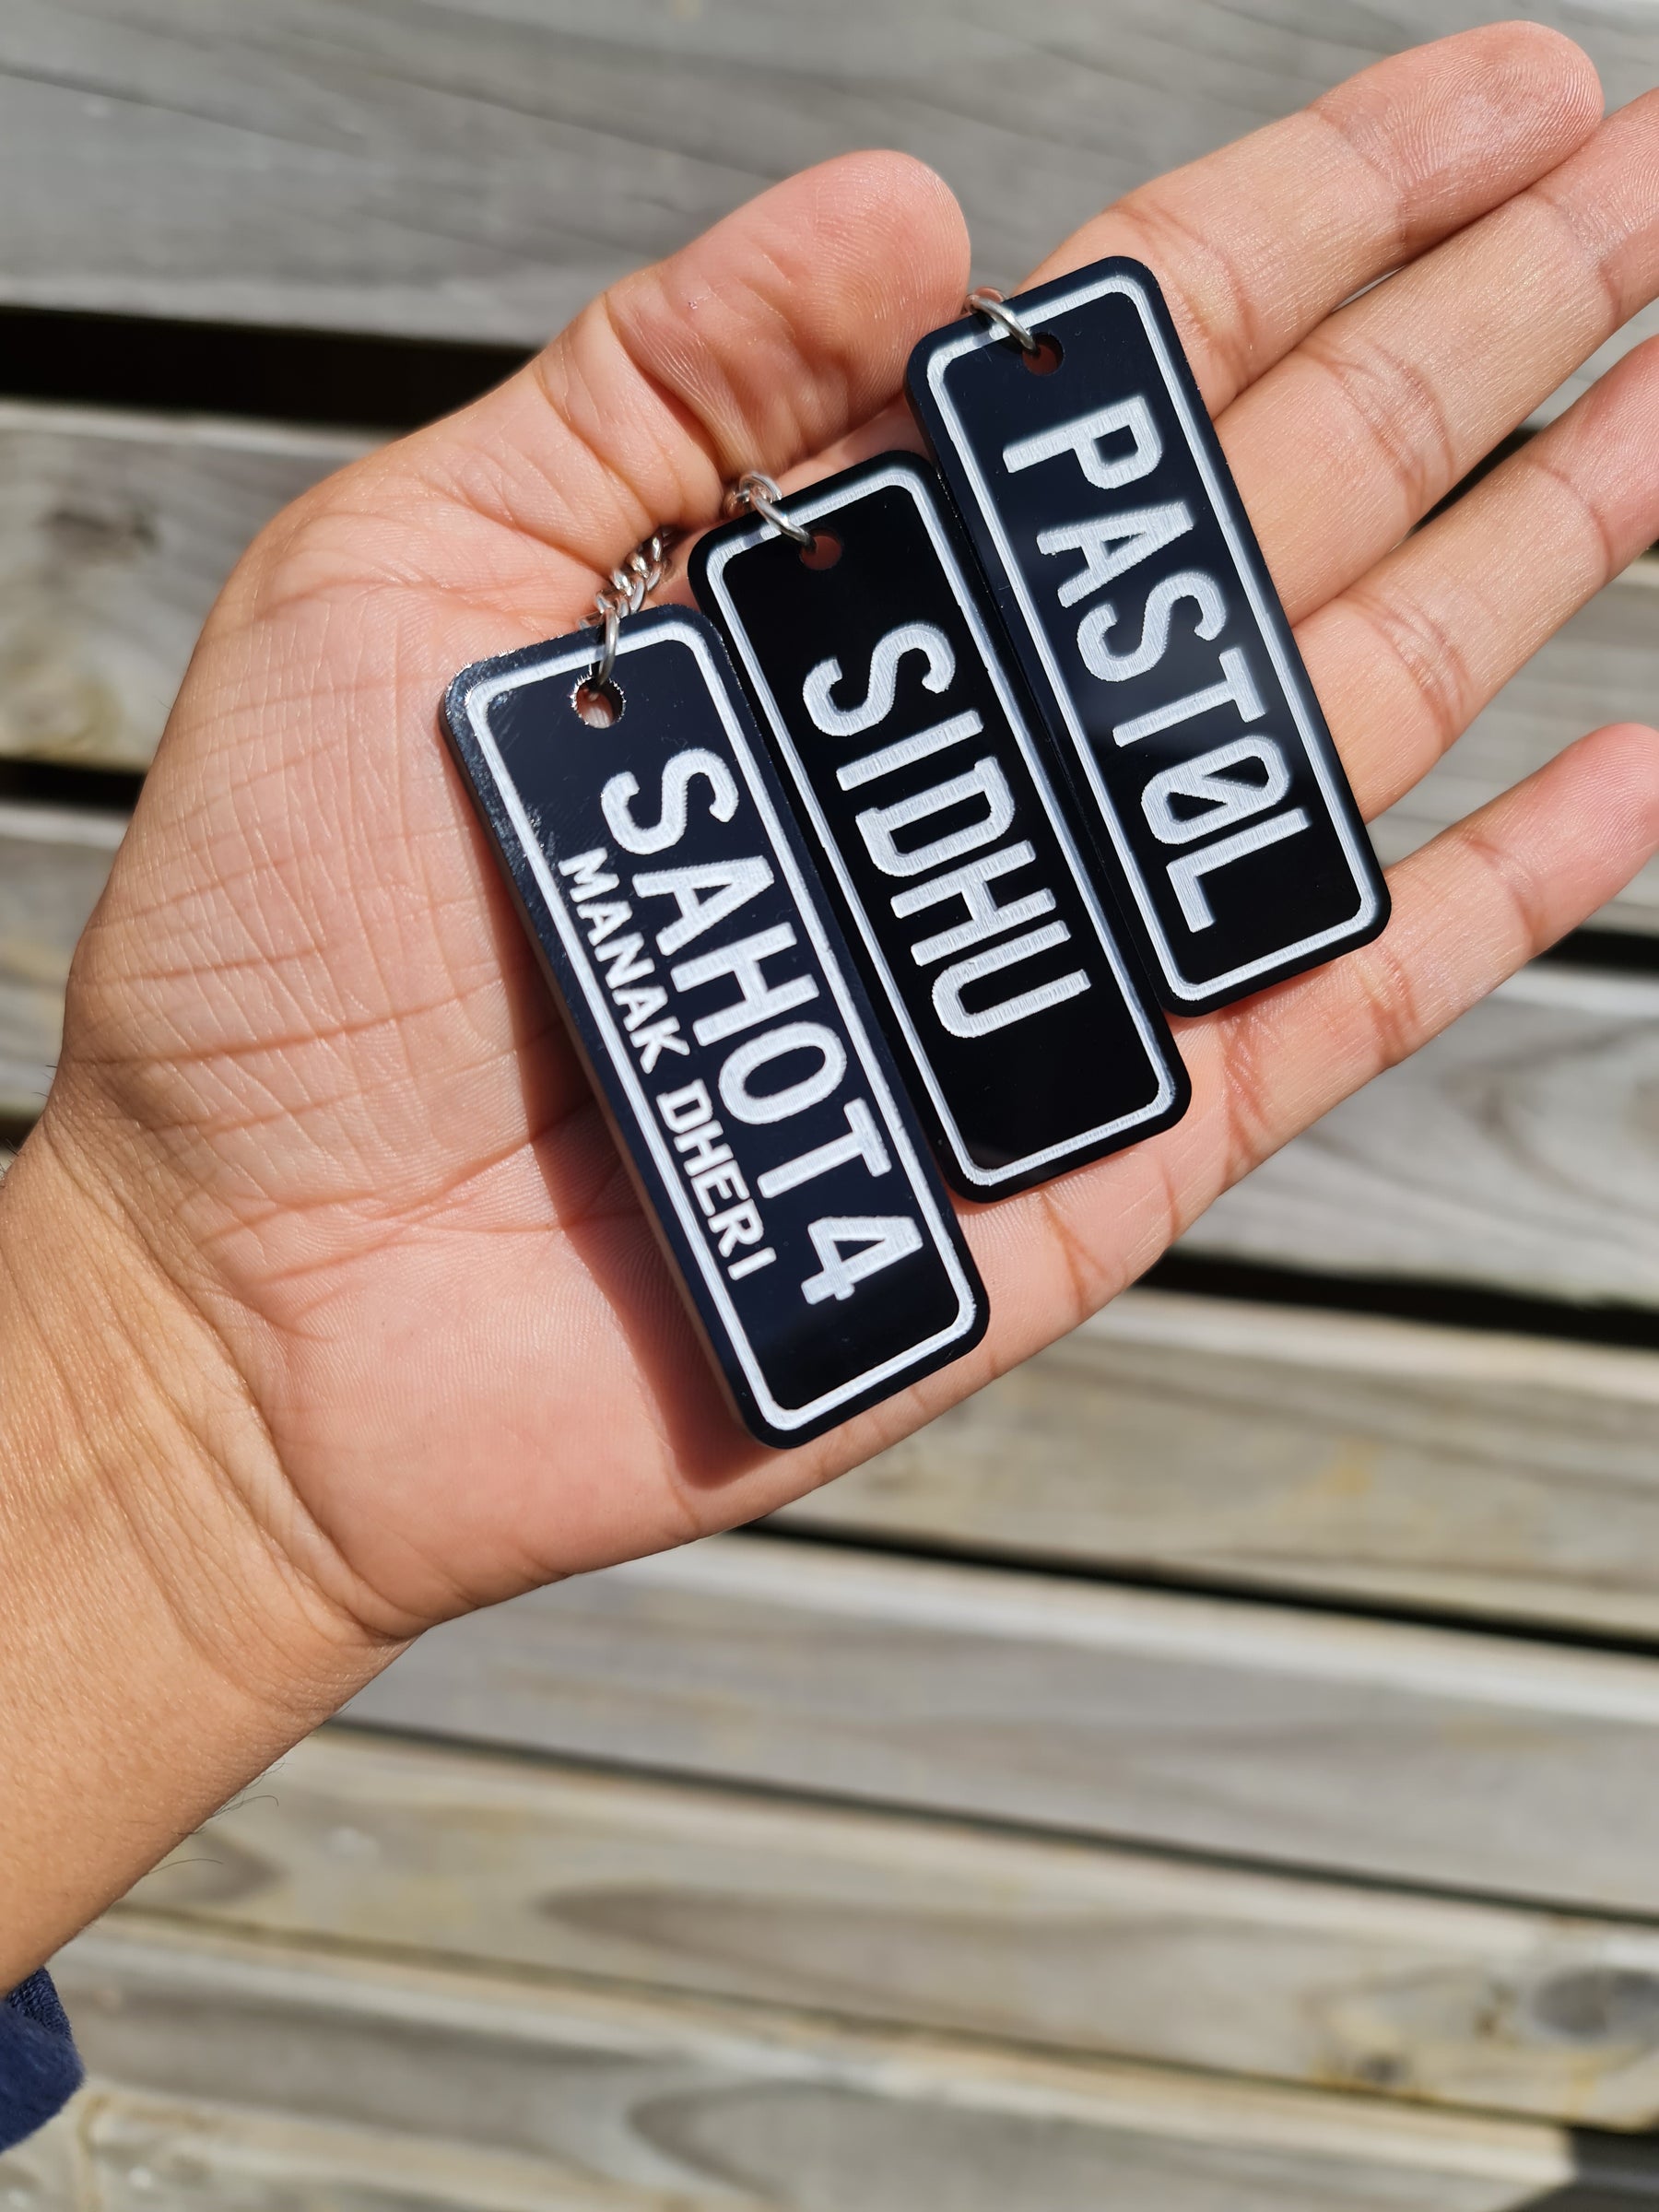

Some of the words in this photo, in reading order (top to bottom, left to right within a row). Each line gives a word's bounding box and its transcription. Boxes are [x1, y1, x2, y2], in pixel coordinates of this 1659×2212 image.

[599, 747, 893, 1199] SAHOT
[800, 1216, 924, 1305] 4
[801, 623, 1092, 1040] SIDHU
[557, 847, 690, 1075] MANAK
[655, 1078, 777, 1281] DHERI
